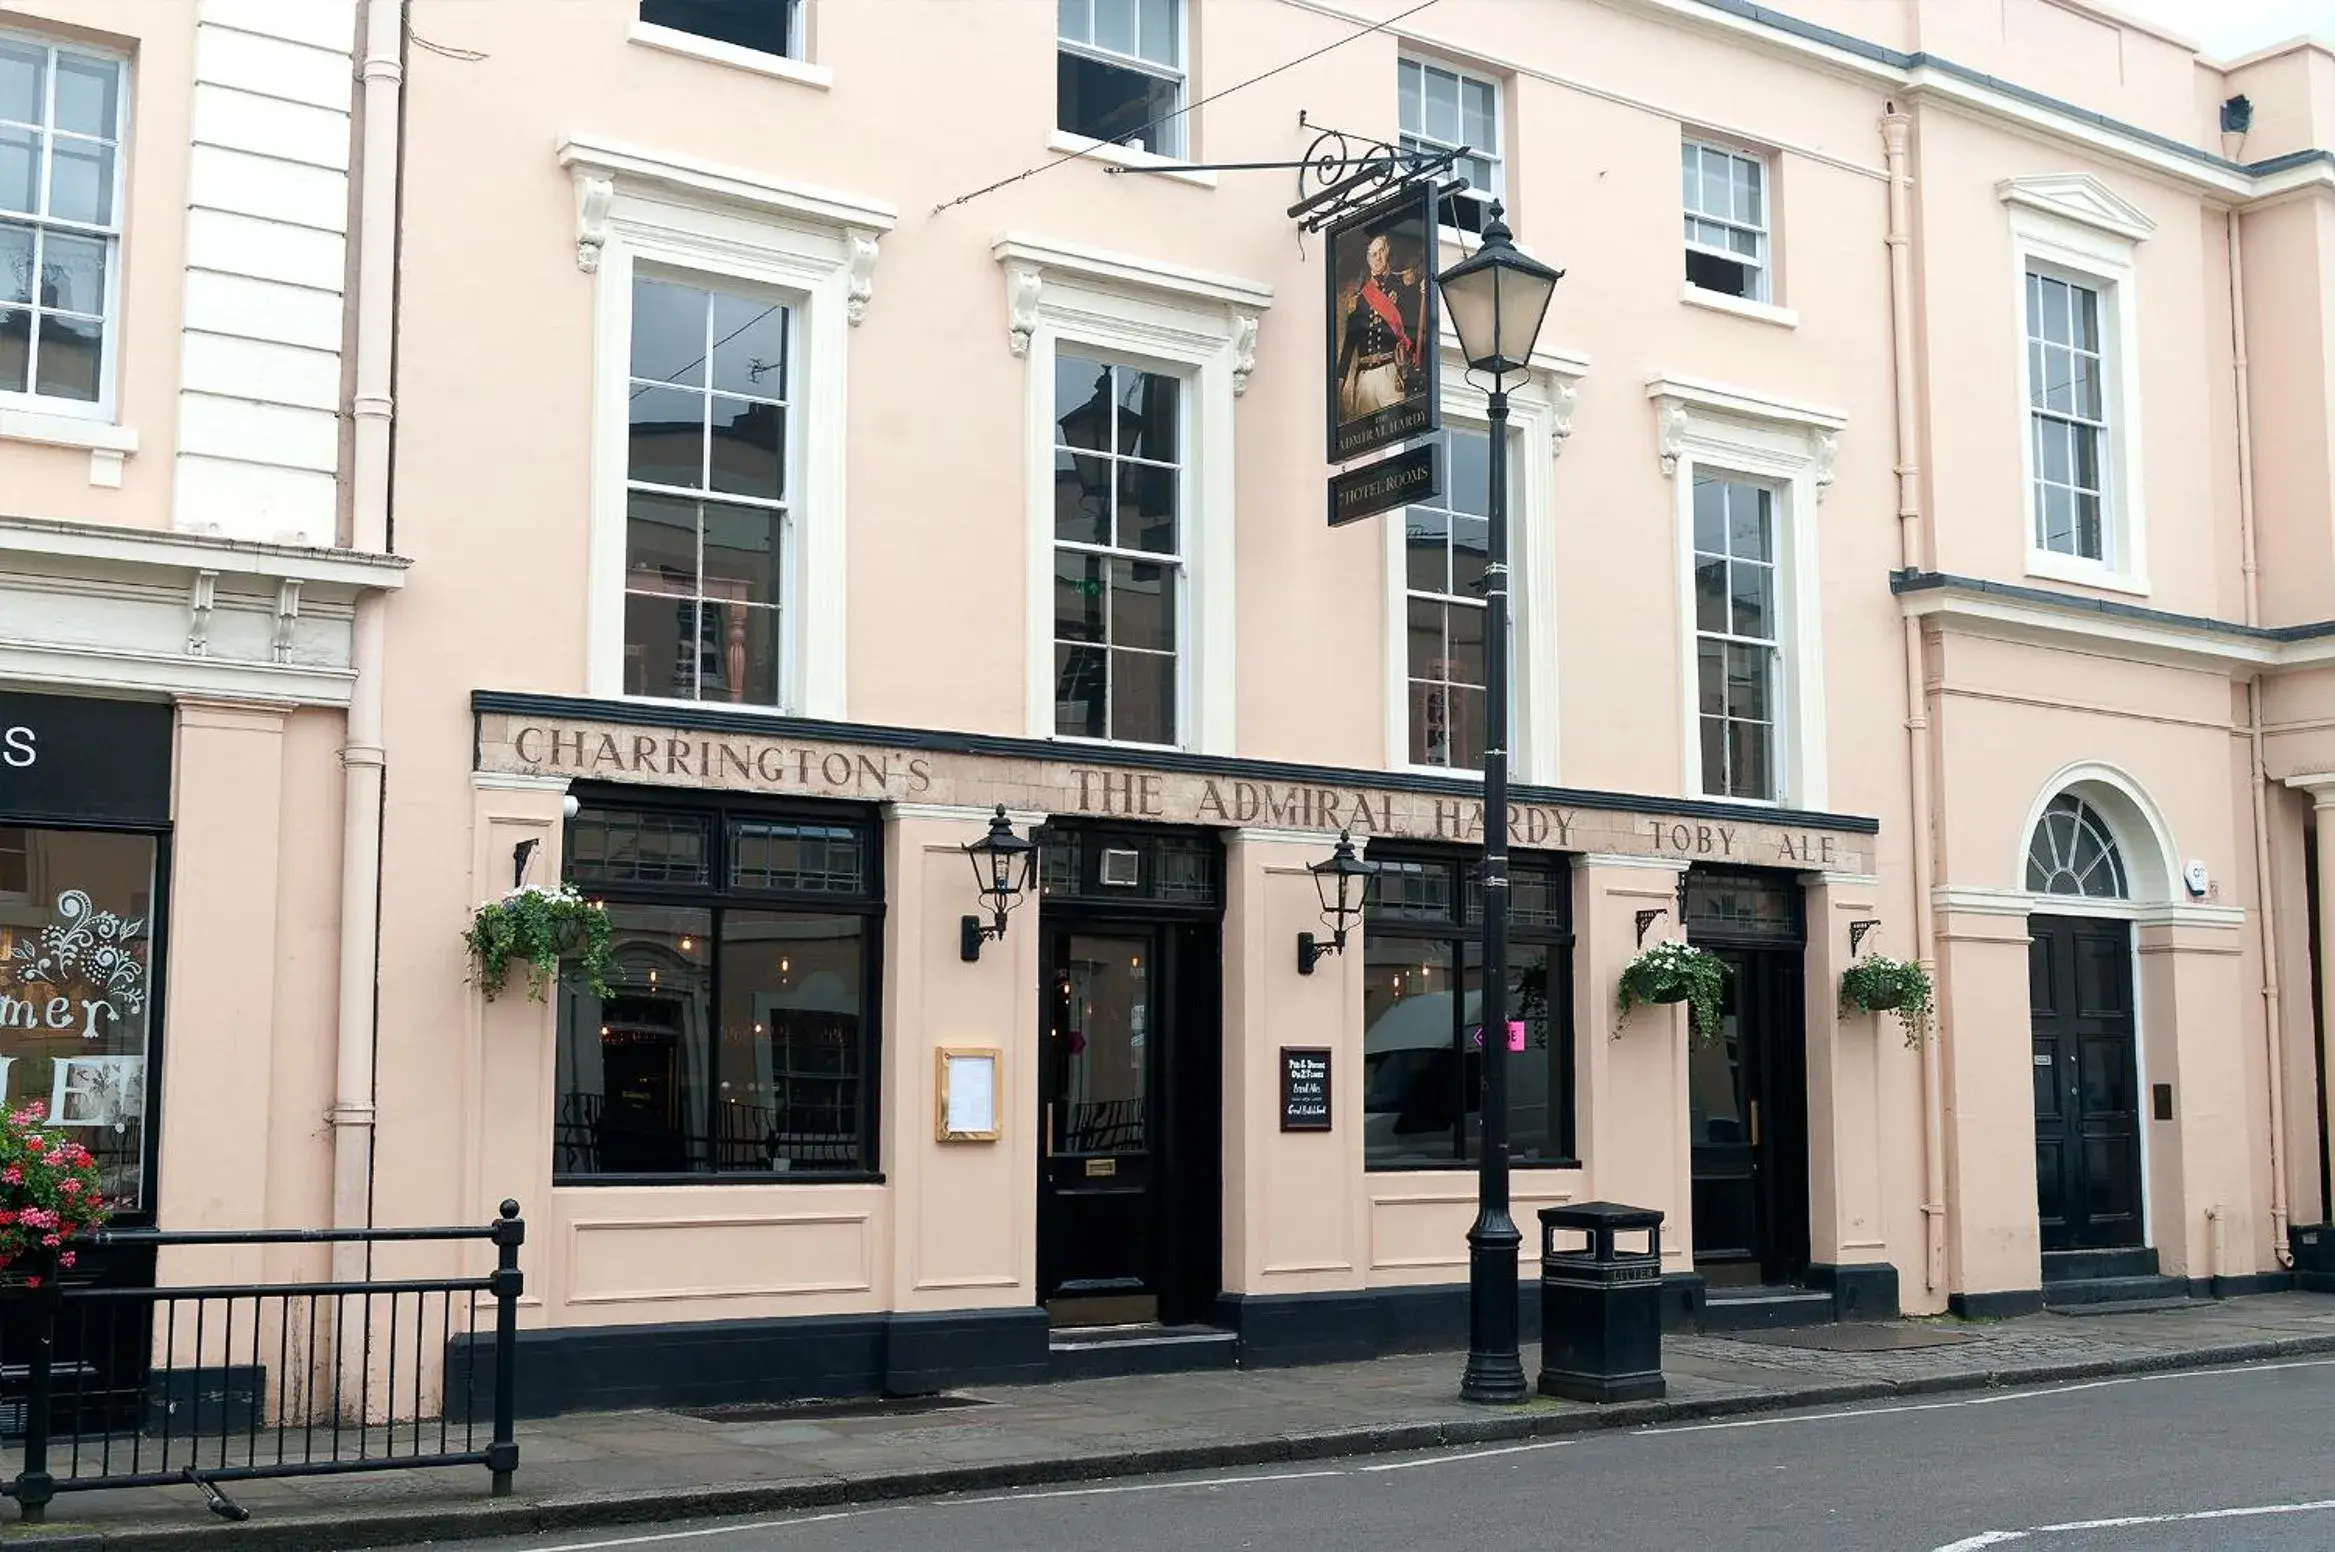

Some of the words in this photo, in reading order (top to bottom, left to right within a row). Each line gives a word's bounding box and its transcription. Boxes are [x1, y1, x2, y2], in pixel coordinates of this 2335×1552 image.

[1339, 426, 1387, 450] ADMIRAL
[1389, 410, 1427, 433] HARDY
[1345, 481, 1383, 506] HOTEL
[1385, 465, 1429, 492] ROOMS
[3, 726, 36, 767] S
[515, 726, 931, 792] CHARRINGTON'S
[1070, 768, 1164, 816] THE
[1195, 779, 1407, 833] ADMIRAL
[1649, 820, 1736, 855] TOBY
[1777, 833, 1836, 864] ALE
[1613, 1268, 1654, 1281] LITTER
